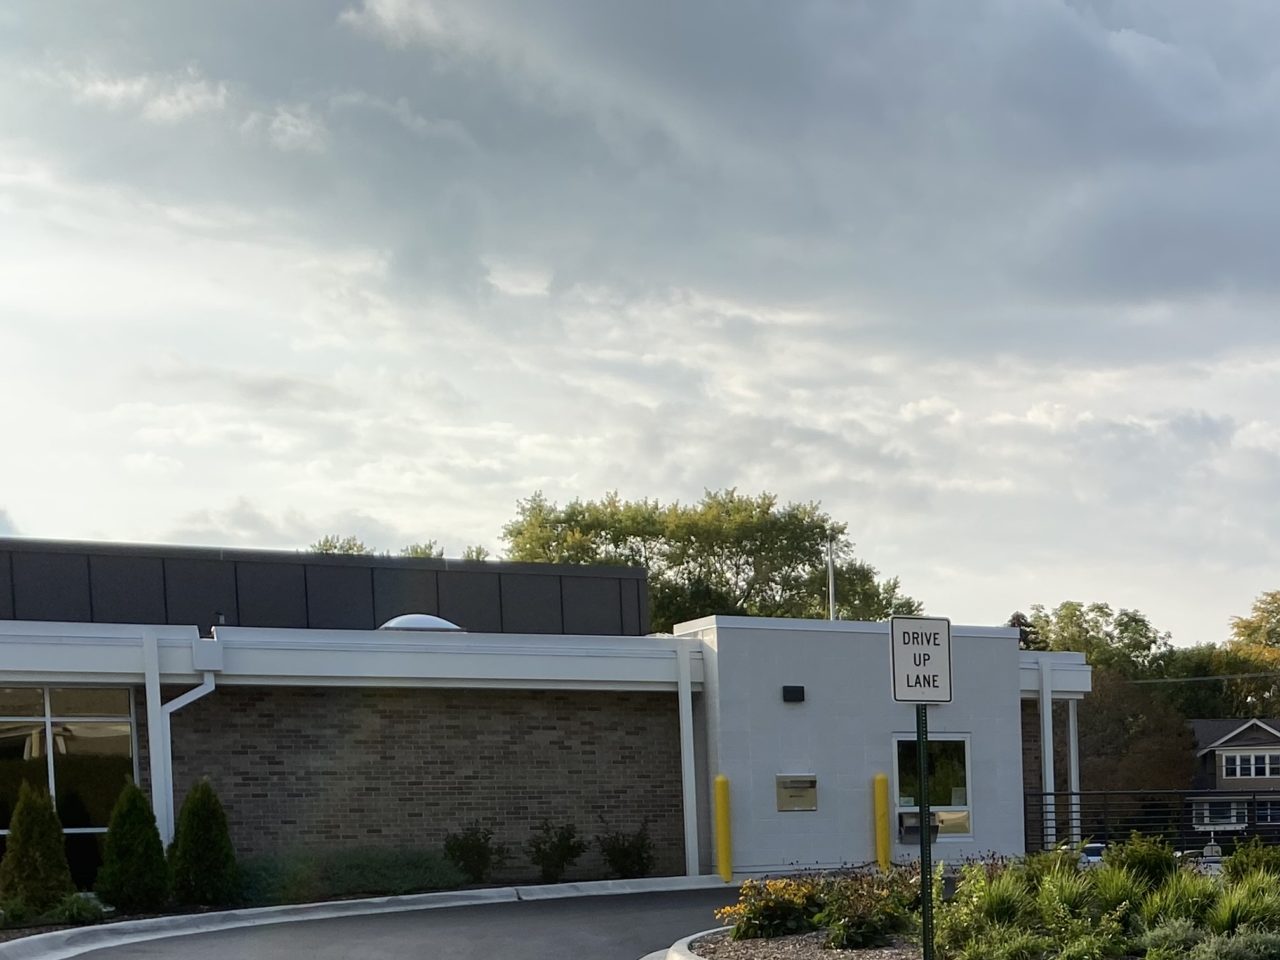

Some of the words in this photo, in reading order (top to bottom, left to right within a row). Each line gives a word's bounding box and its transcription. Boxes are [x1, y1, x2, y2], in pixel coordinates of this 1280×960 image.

[902, 631, 941, 646] DRIVE
[913, 653, 931, 667] UP
[906, 674, 940, 688] LANE
